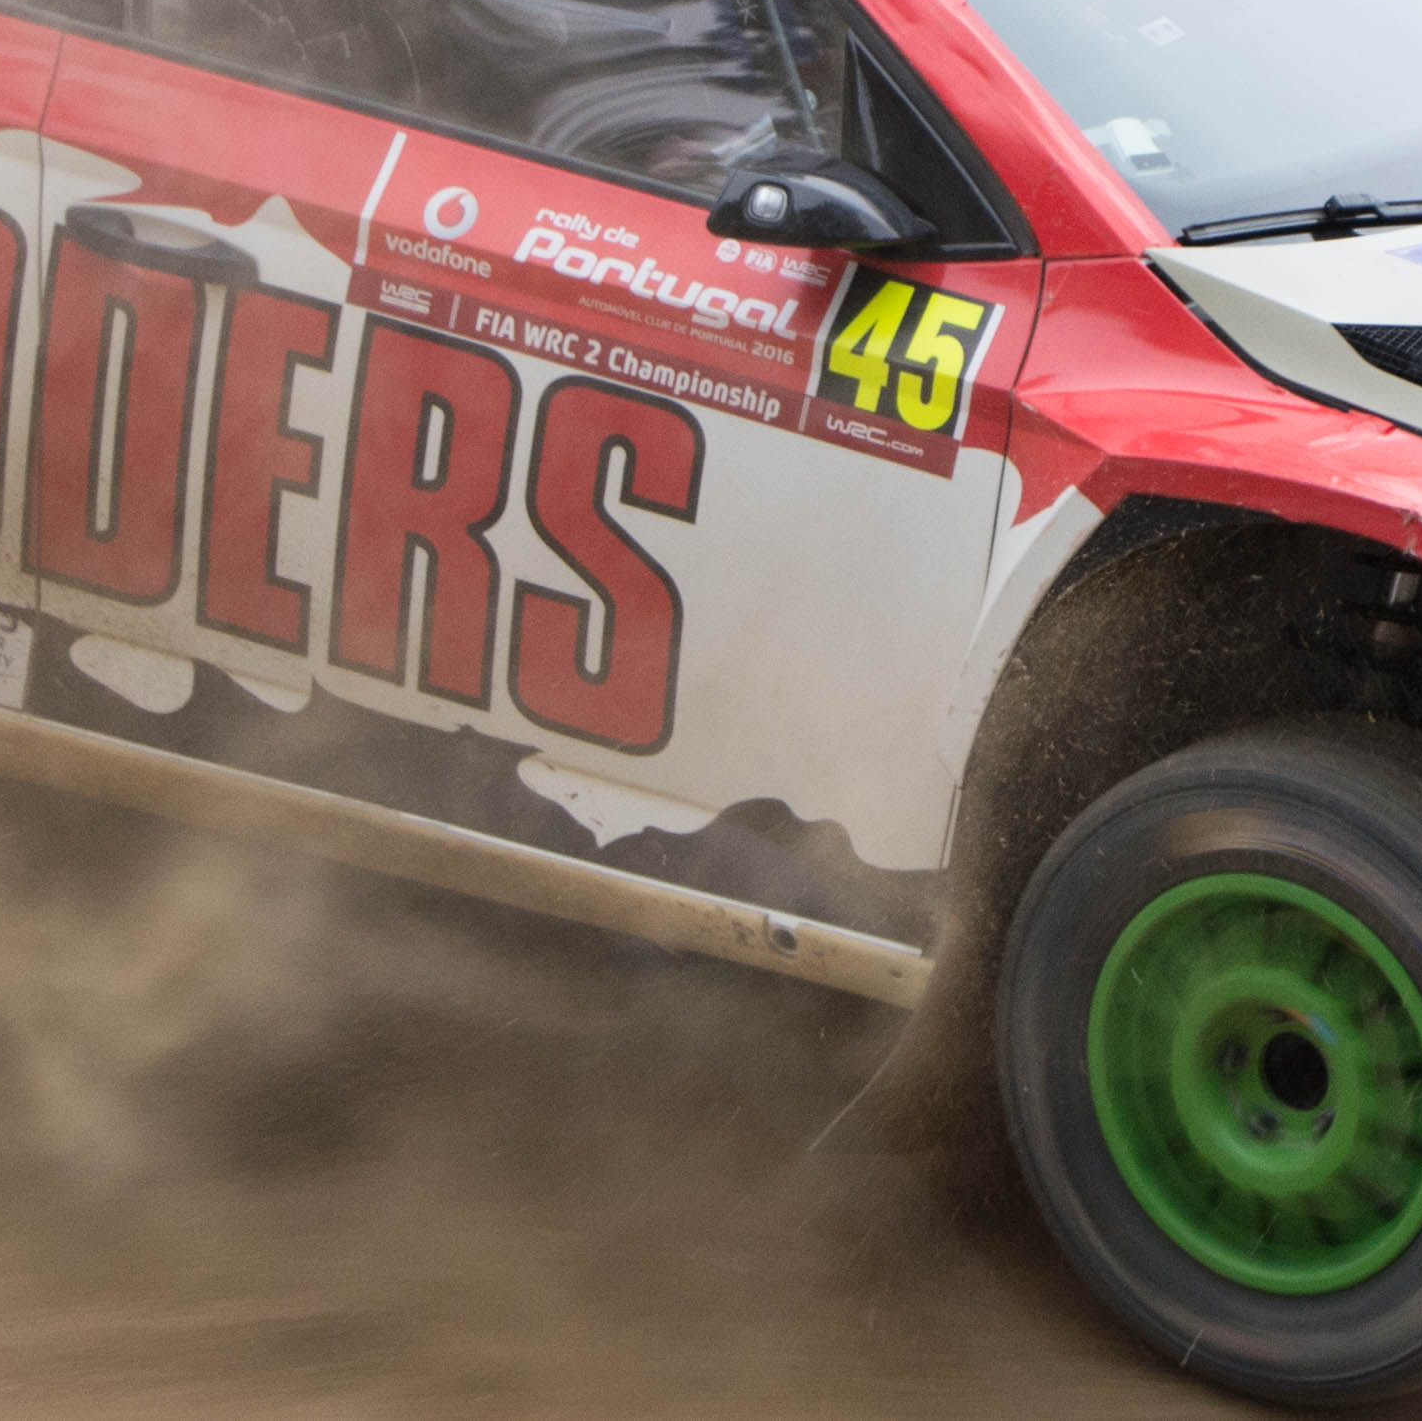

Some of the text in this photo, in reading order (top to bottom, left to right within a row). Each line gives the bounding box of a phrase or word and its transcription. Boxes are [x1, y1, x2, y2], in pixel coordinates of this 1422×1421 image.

[385, 232, 493, 279] vodafone
[535, 207, 640, 249] rally de
[514, 227, 800, 341] Portugal
[475, 307, 516, 343] FIA
[524, 319, 580, 360] WRC
[584, 340, 603, 366] 2
[608, 346, 781, 422] Championship
[689, 327, 749, 354] PORTUGAL
[751, 340, 796, 366] 2016
[829, 280, 985, 431] 45
